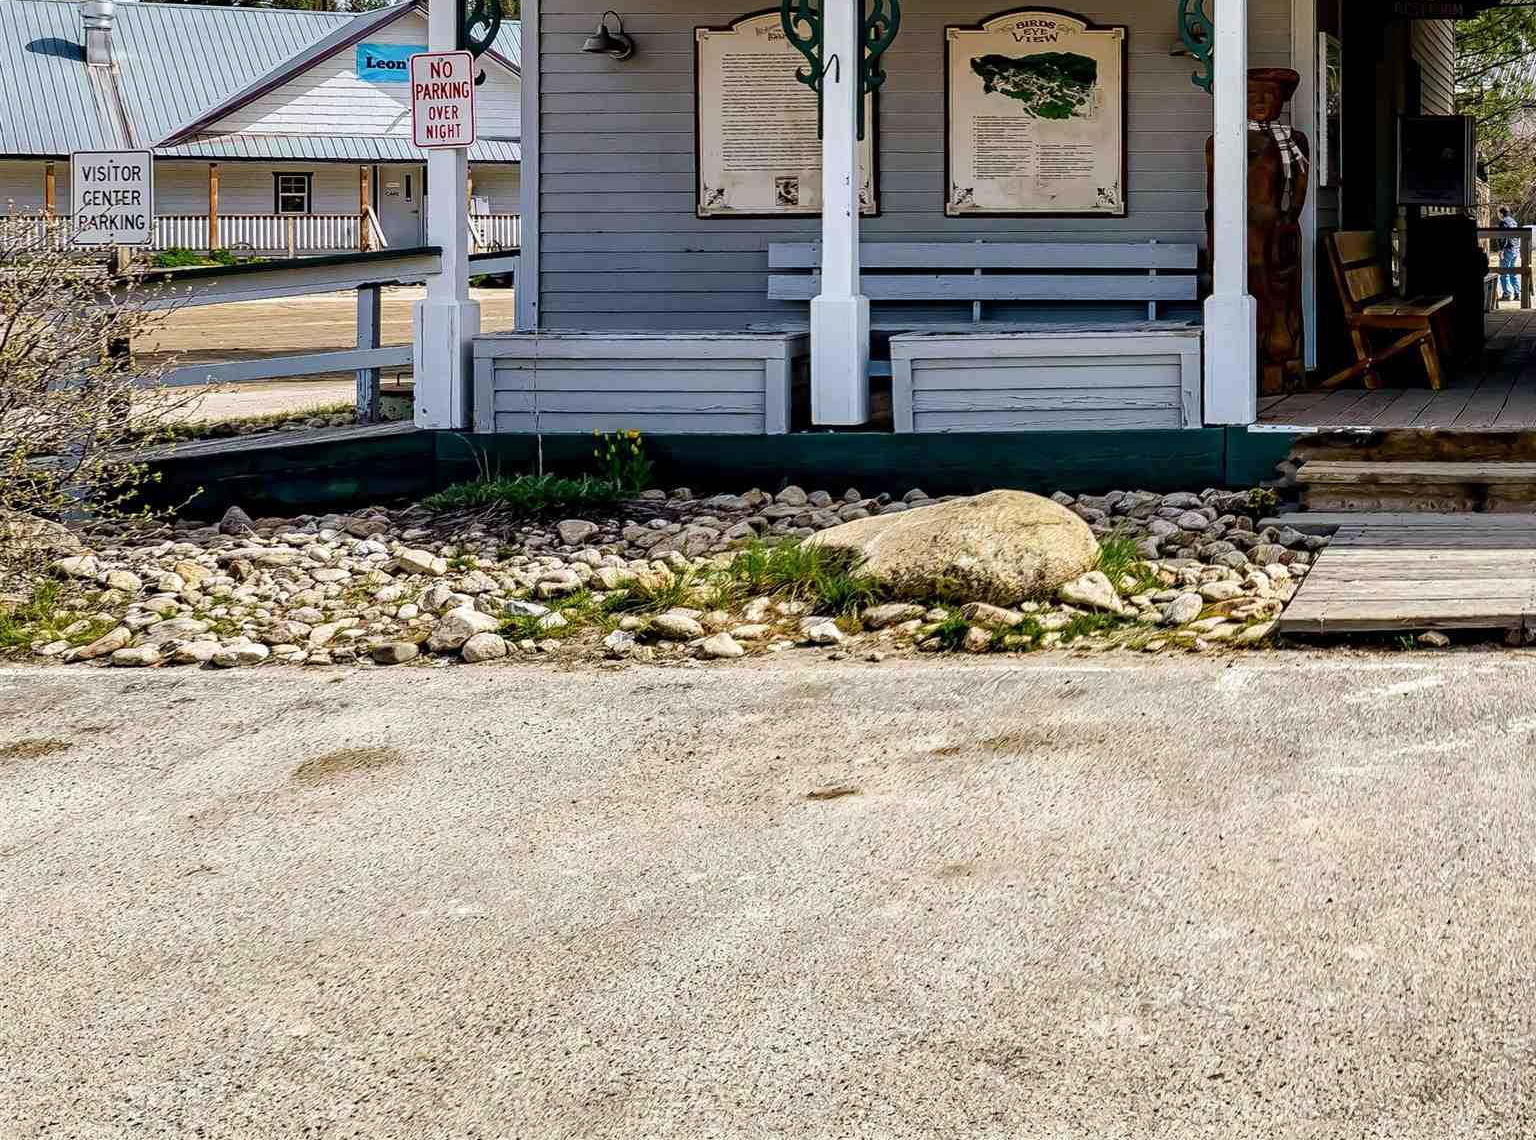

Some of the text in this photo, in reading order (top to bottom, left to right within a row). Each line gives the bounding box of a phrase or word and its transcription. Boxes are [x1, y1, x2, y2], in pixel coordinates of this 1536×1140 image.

[1011, 32, 1059, 43] VIEW
[430, 61, 453, 79] NO
[415, 81, 470, 101] PARKING
[428, 105, 459, 121] OVER
[426, 123, 462, 140] NIGHT
[82, 165, 142, 181] VISITOR
[82, 190, 142, 206] CENTER
[79, 214, 145, 230] PARKING
